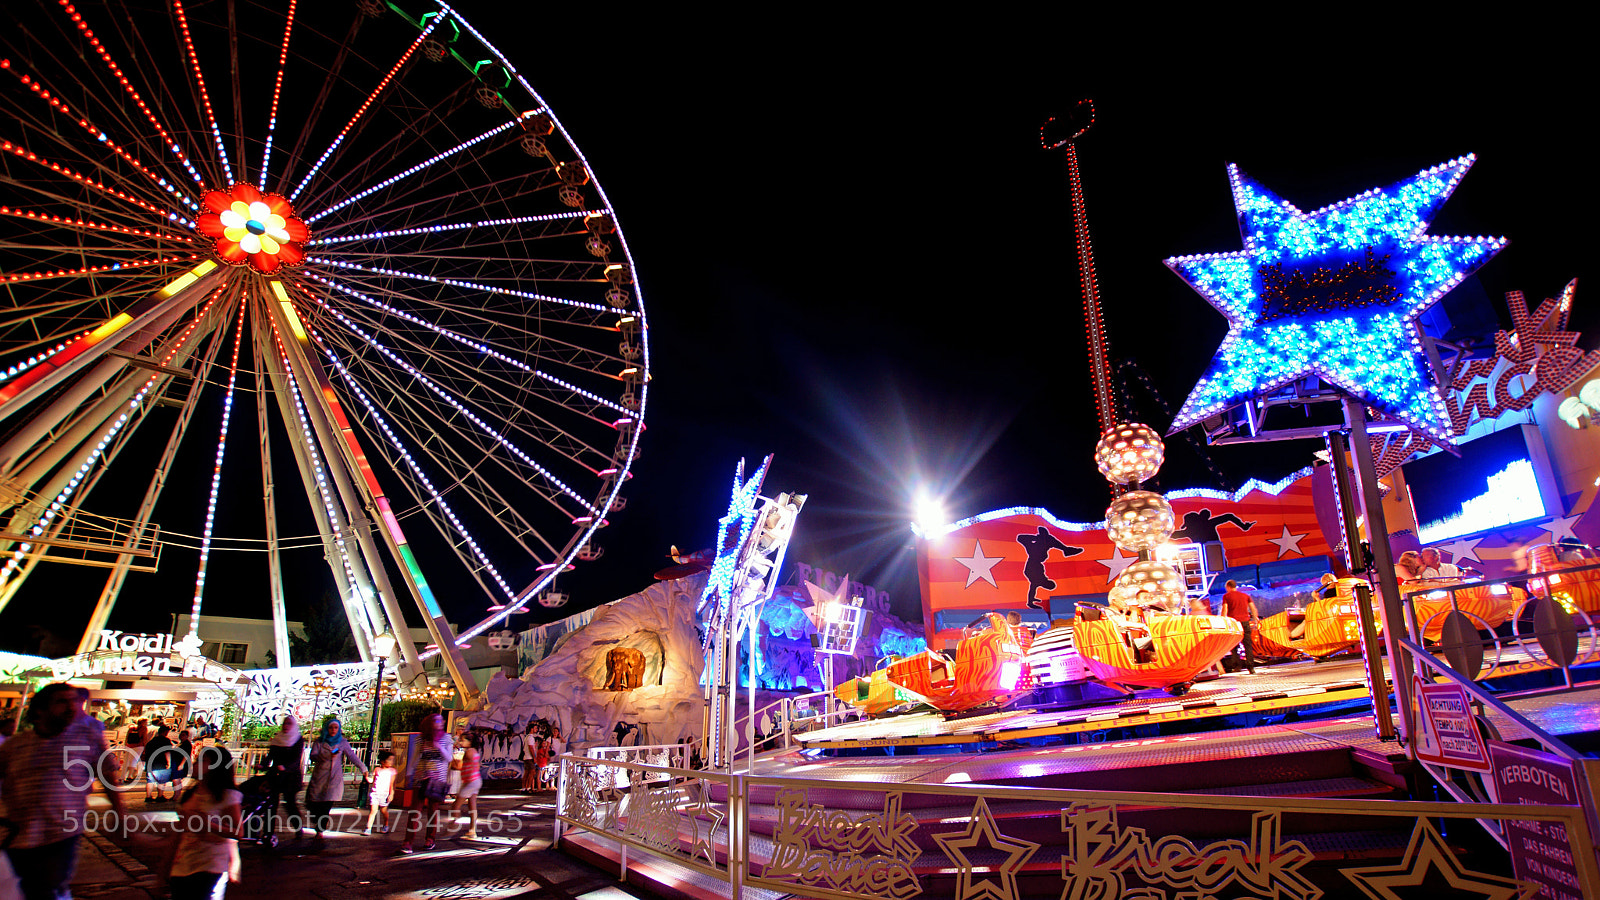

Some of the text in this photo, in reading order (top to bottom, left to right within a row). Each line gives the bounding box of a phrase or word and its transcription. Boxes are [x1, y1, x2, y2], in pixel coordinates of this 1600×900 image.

[795, 561, 891, 614] EISERG
[97, 629, 174, 654] Koidl
[51, 654, 173, 682] Blumen
[1112, 707, 1222, 726] FEELING
[1430, 699, 1462, 711] ACHTUNG
[1435, 718, 1453, 730] TEMPO
[858, 739, 900, 747] SOUND
[1060, 738, 1167, 753] STOP
[1499, 764, 1570, 802] VERBOTEN
[773, 786, 922, 865] Break
[1060, 800, 1326, 900] Break
[1522, 836, 1574, 867] DAS FAHREN
[761, 847, 924, 900] Dance
[1525, 856, 1543, 875] VON
[1542, 862, 1582, 891] KINDERN
